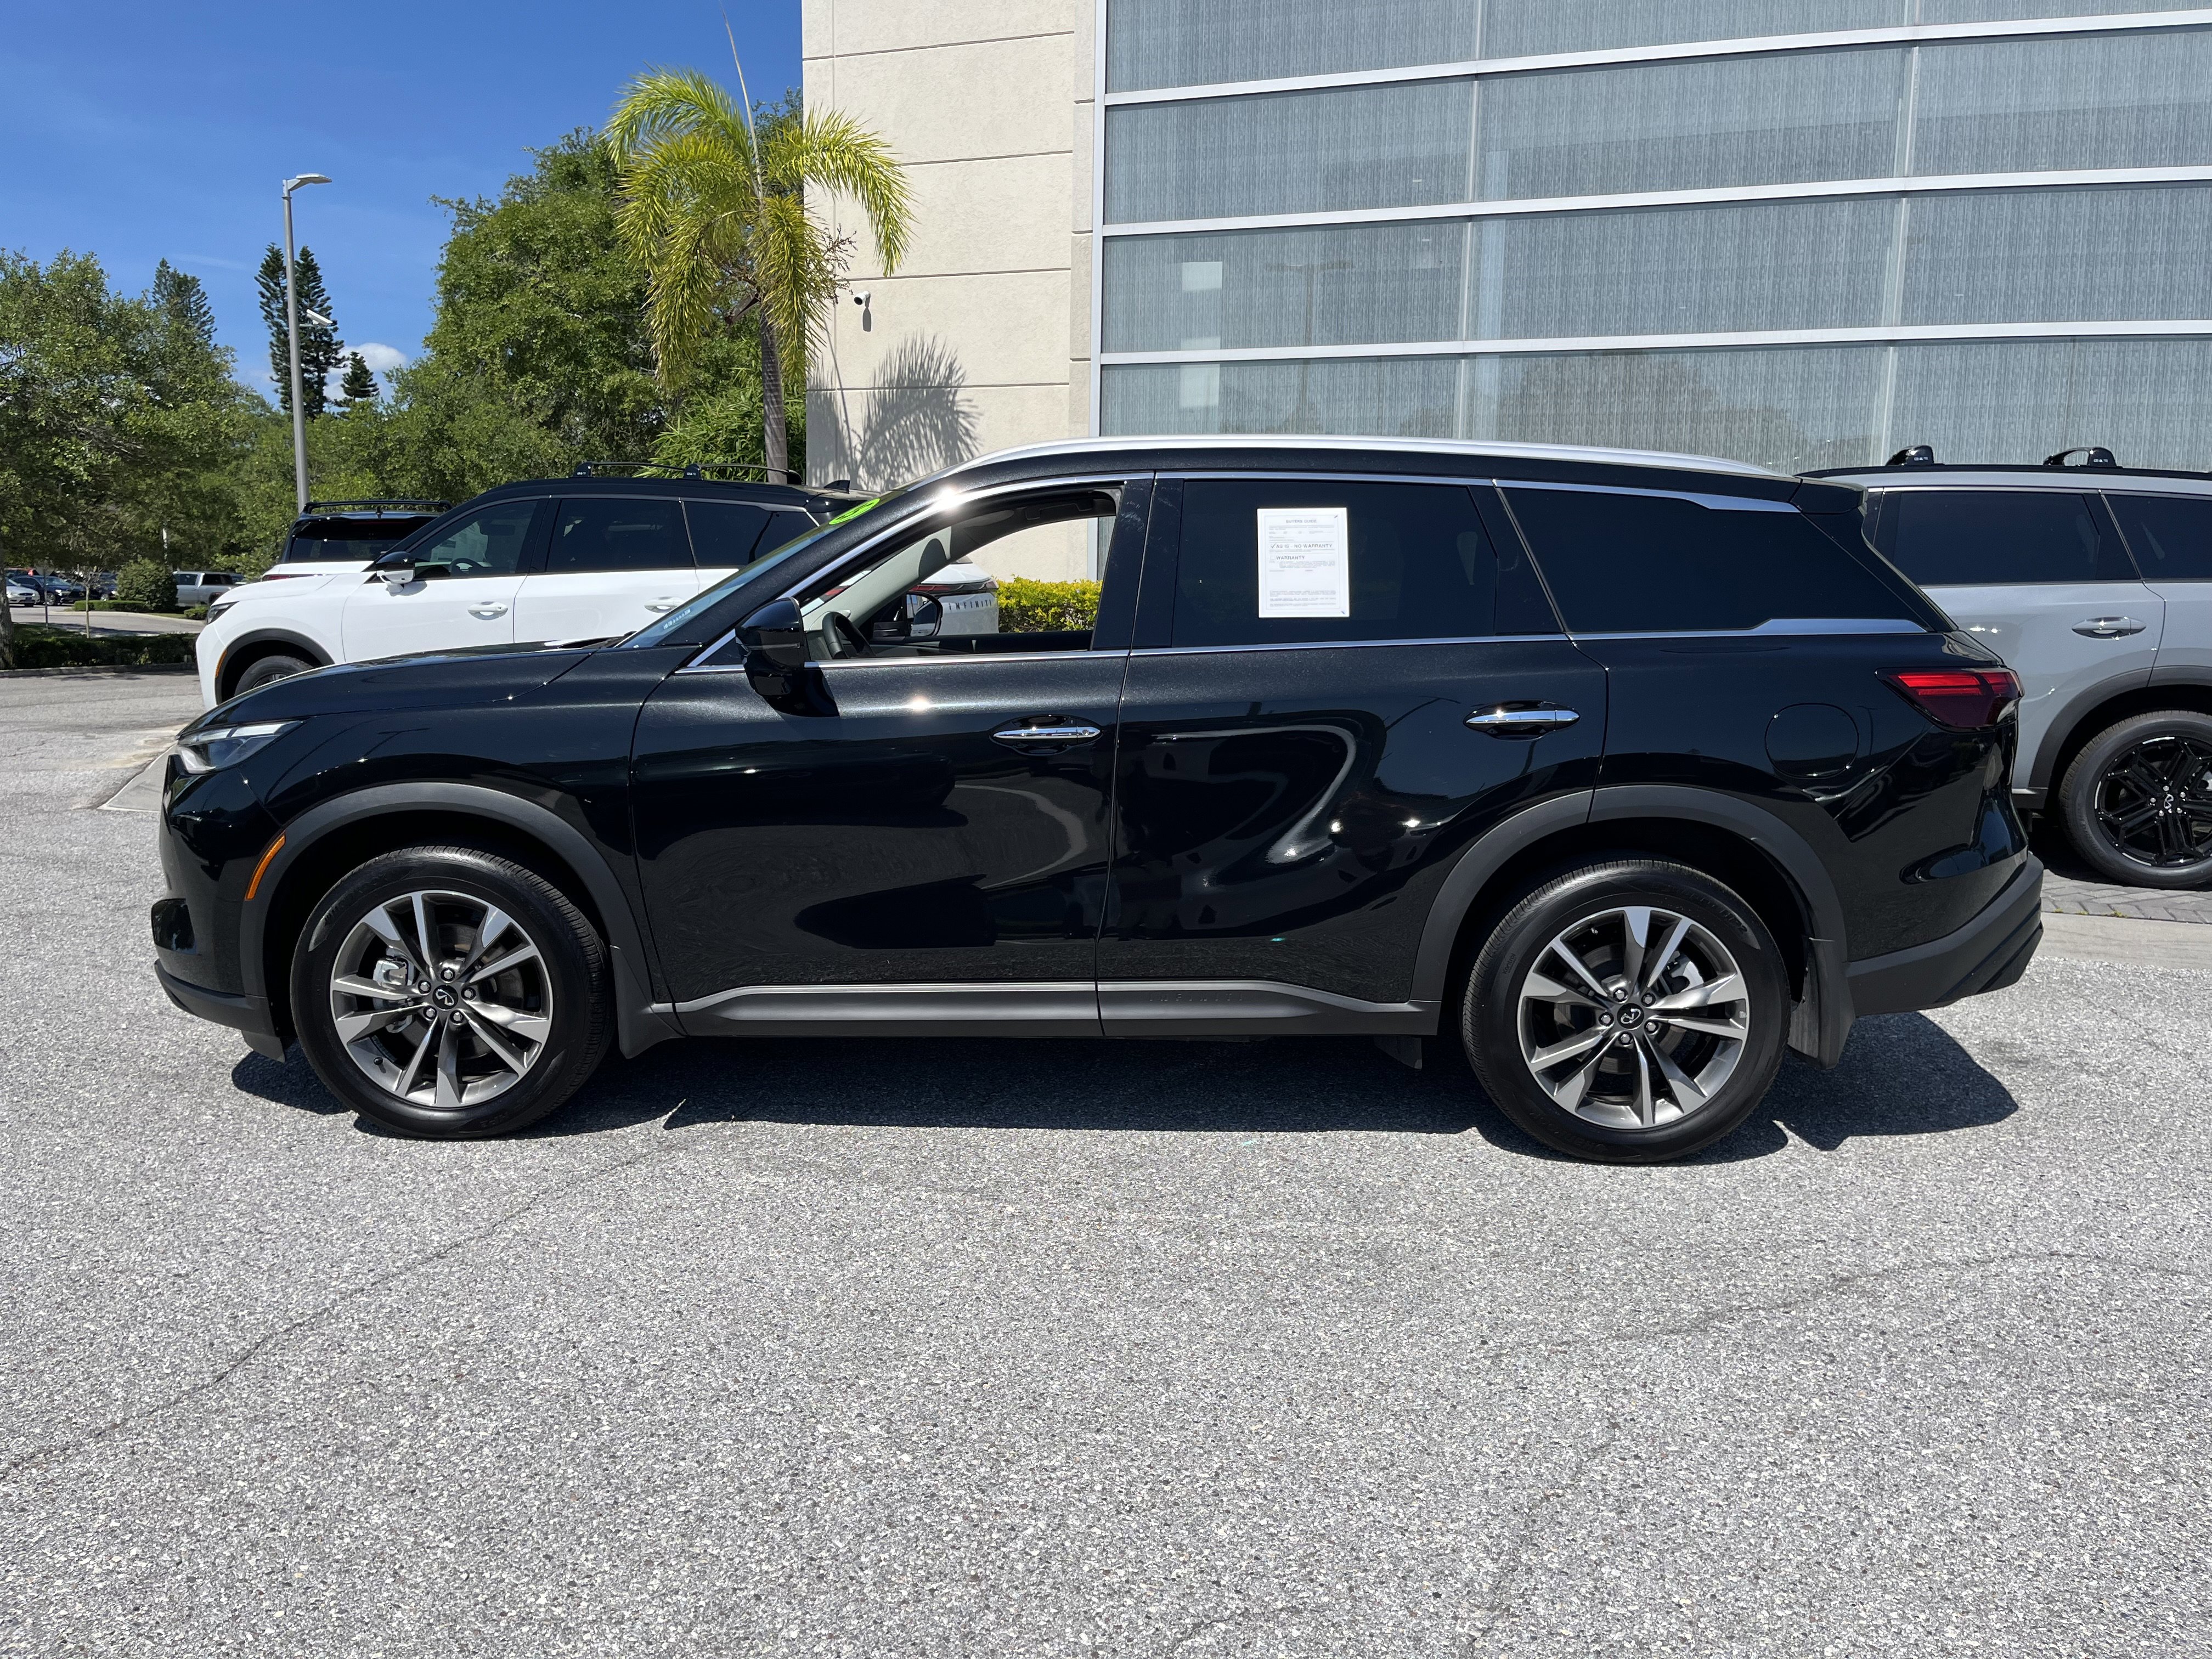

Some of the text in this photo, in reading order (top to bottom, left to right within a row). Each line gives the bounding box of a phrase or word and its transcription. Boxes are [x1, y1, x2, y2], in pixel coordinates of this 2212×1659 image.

[949, 600, 992, 610] INFINITI
[1502, 953, 1516, 975] Kontrol
[1149, 991, 1243, 1002] INFINITI
